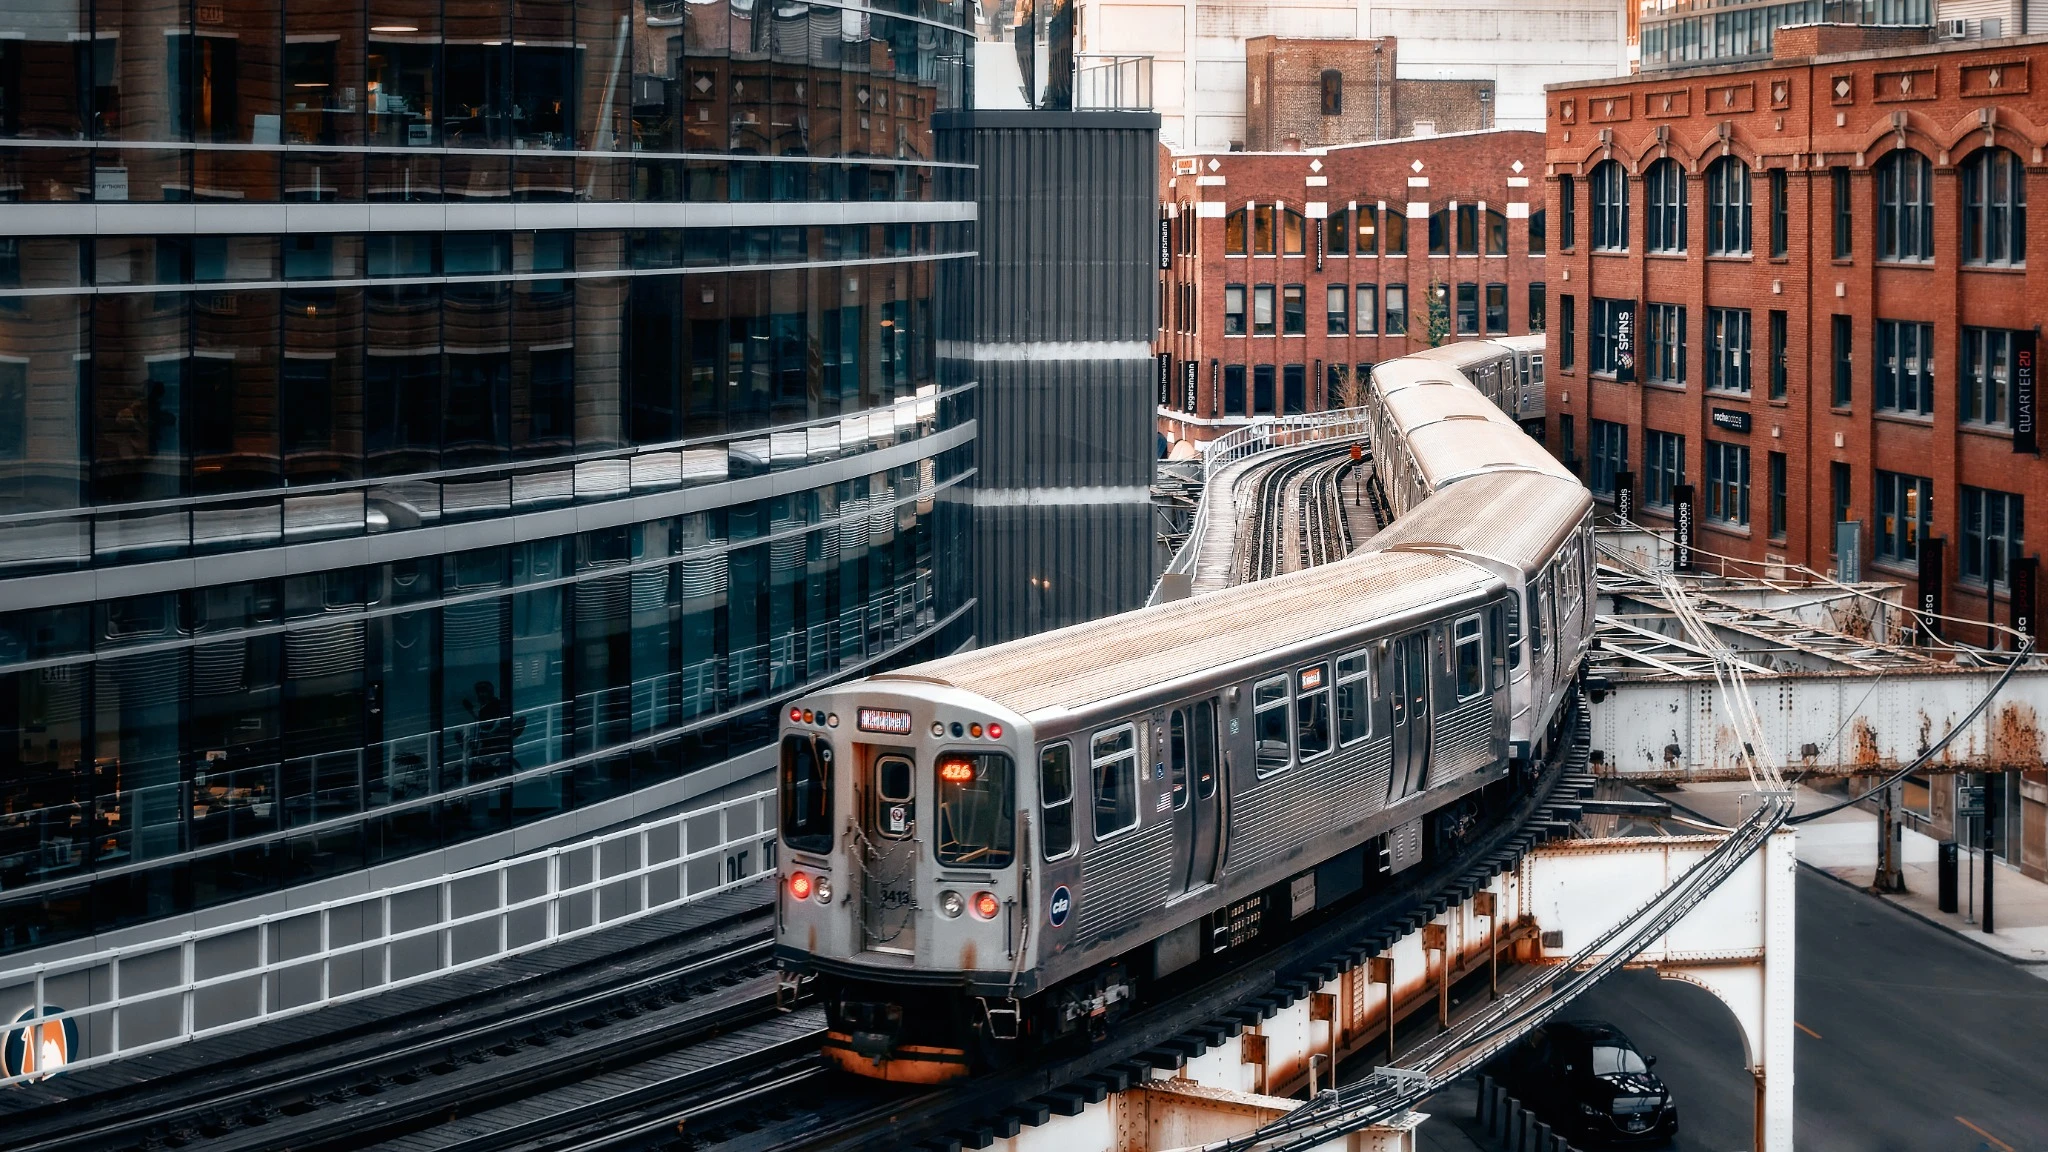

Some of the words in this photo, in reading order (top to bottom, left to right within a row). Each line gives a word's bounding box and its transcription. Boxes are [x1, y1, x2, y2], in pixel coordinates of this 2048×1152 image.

[1618, 311, 1629, 350] SPINS
[1187, 363, 1196, 411] eggersmann
[1679, 502, 1688, 567] rochebobois
[2018, 617, 2027, 649] csa
[942, 764, 971, 779] 426
[1052, 898, 1068, 914] cta
